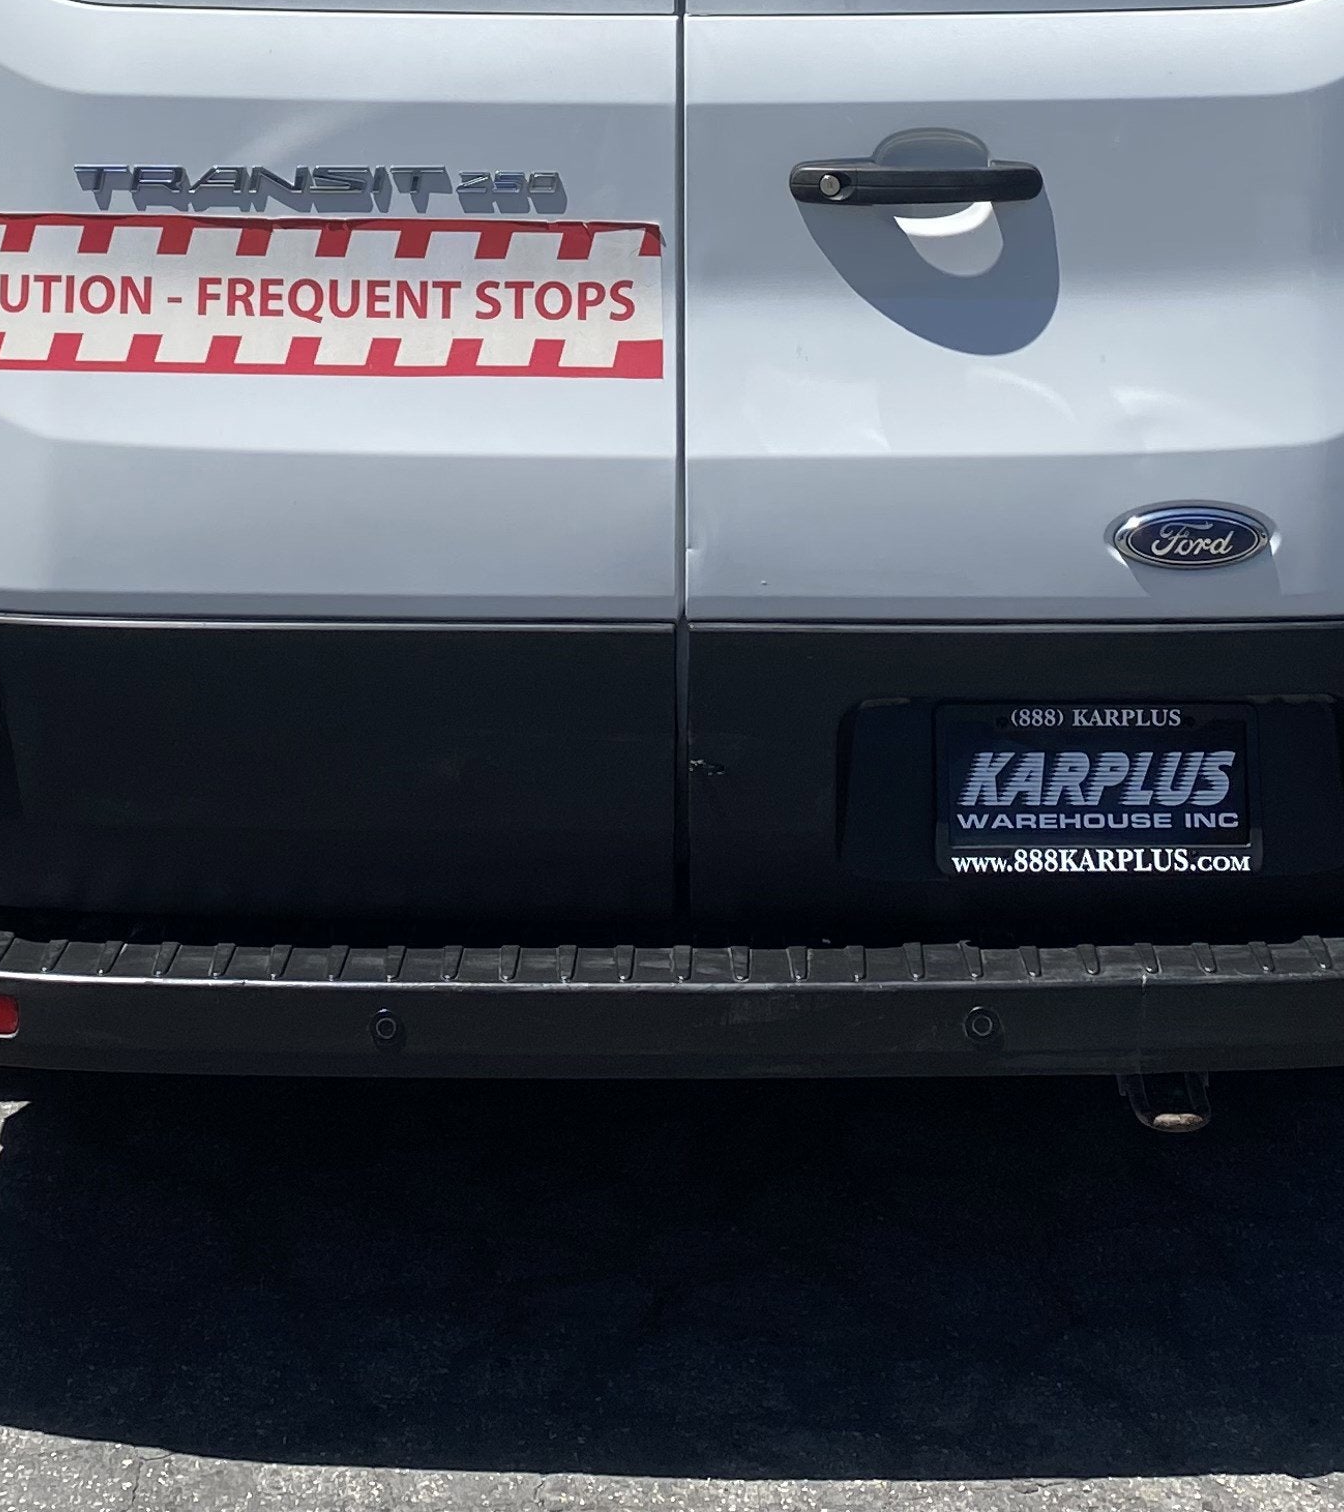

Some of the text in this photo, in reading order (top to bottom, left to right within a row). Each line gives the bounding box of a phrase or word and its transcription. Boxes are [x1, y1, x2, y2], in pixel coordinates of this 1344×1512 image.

[74, 164, 558, 193] TRANSIT 250
[196, 276, 462, 323] FREQUENT
[474, 278, 635, 323] STOPS
[1151, 520, 1234, 557] Ford
[1010, 708, 1182, 727] (888) KARPLUS
[957, 751, 1236, 806] KARPLUS
[957, 812, 1239, 829] WAREHOUSE INC
